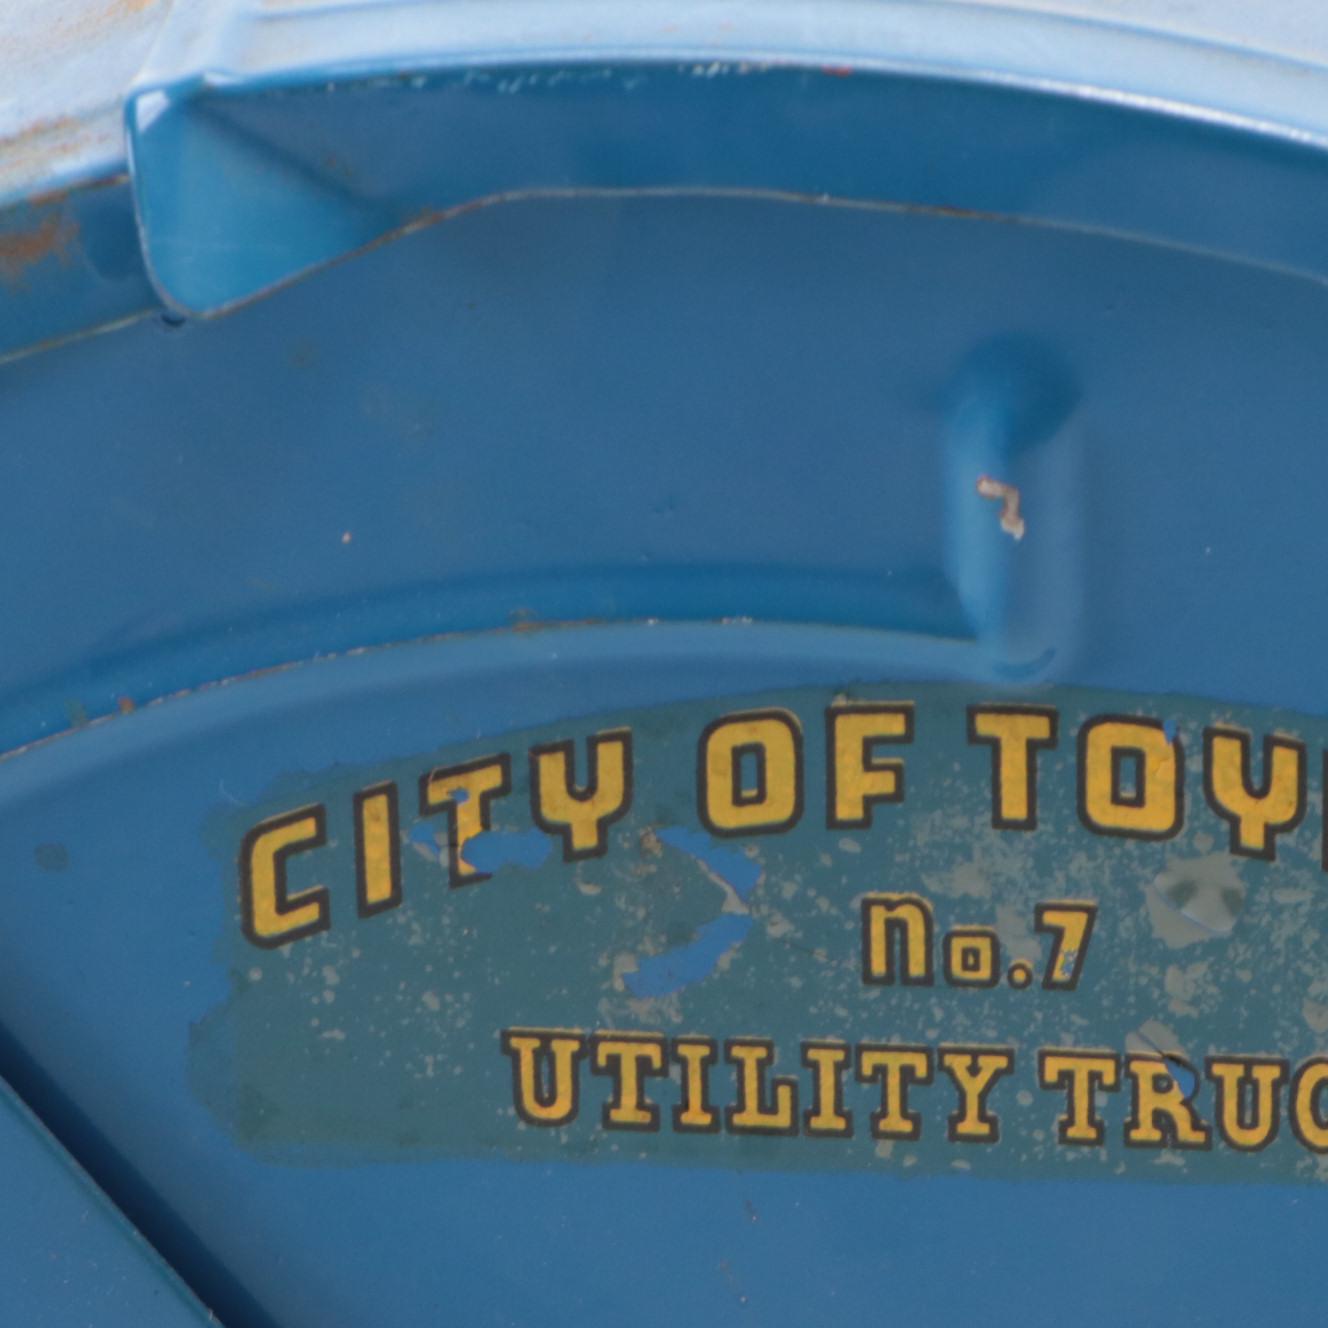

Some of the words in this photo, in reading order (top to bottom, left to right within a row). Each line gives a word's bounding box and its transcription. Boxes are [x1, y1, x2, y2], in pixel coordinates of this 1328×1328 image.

[240, 727, 632, 949] CITY
[698, 701, 914, 838] OF
[502, 1027, 1014, 1144] UTILITY
